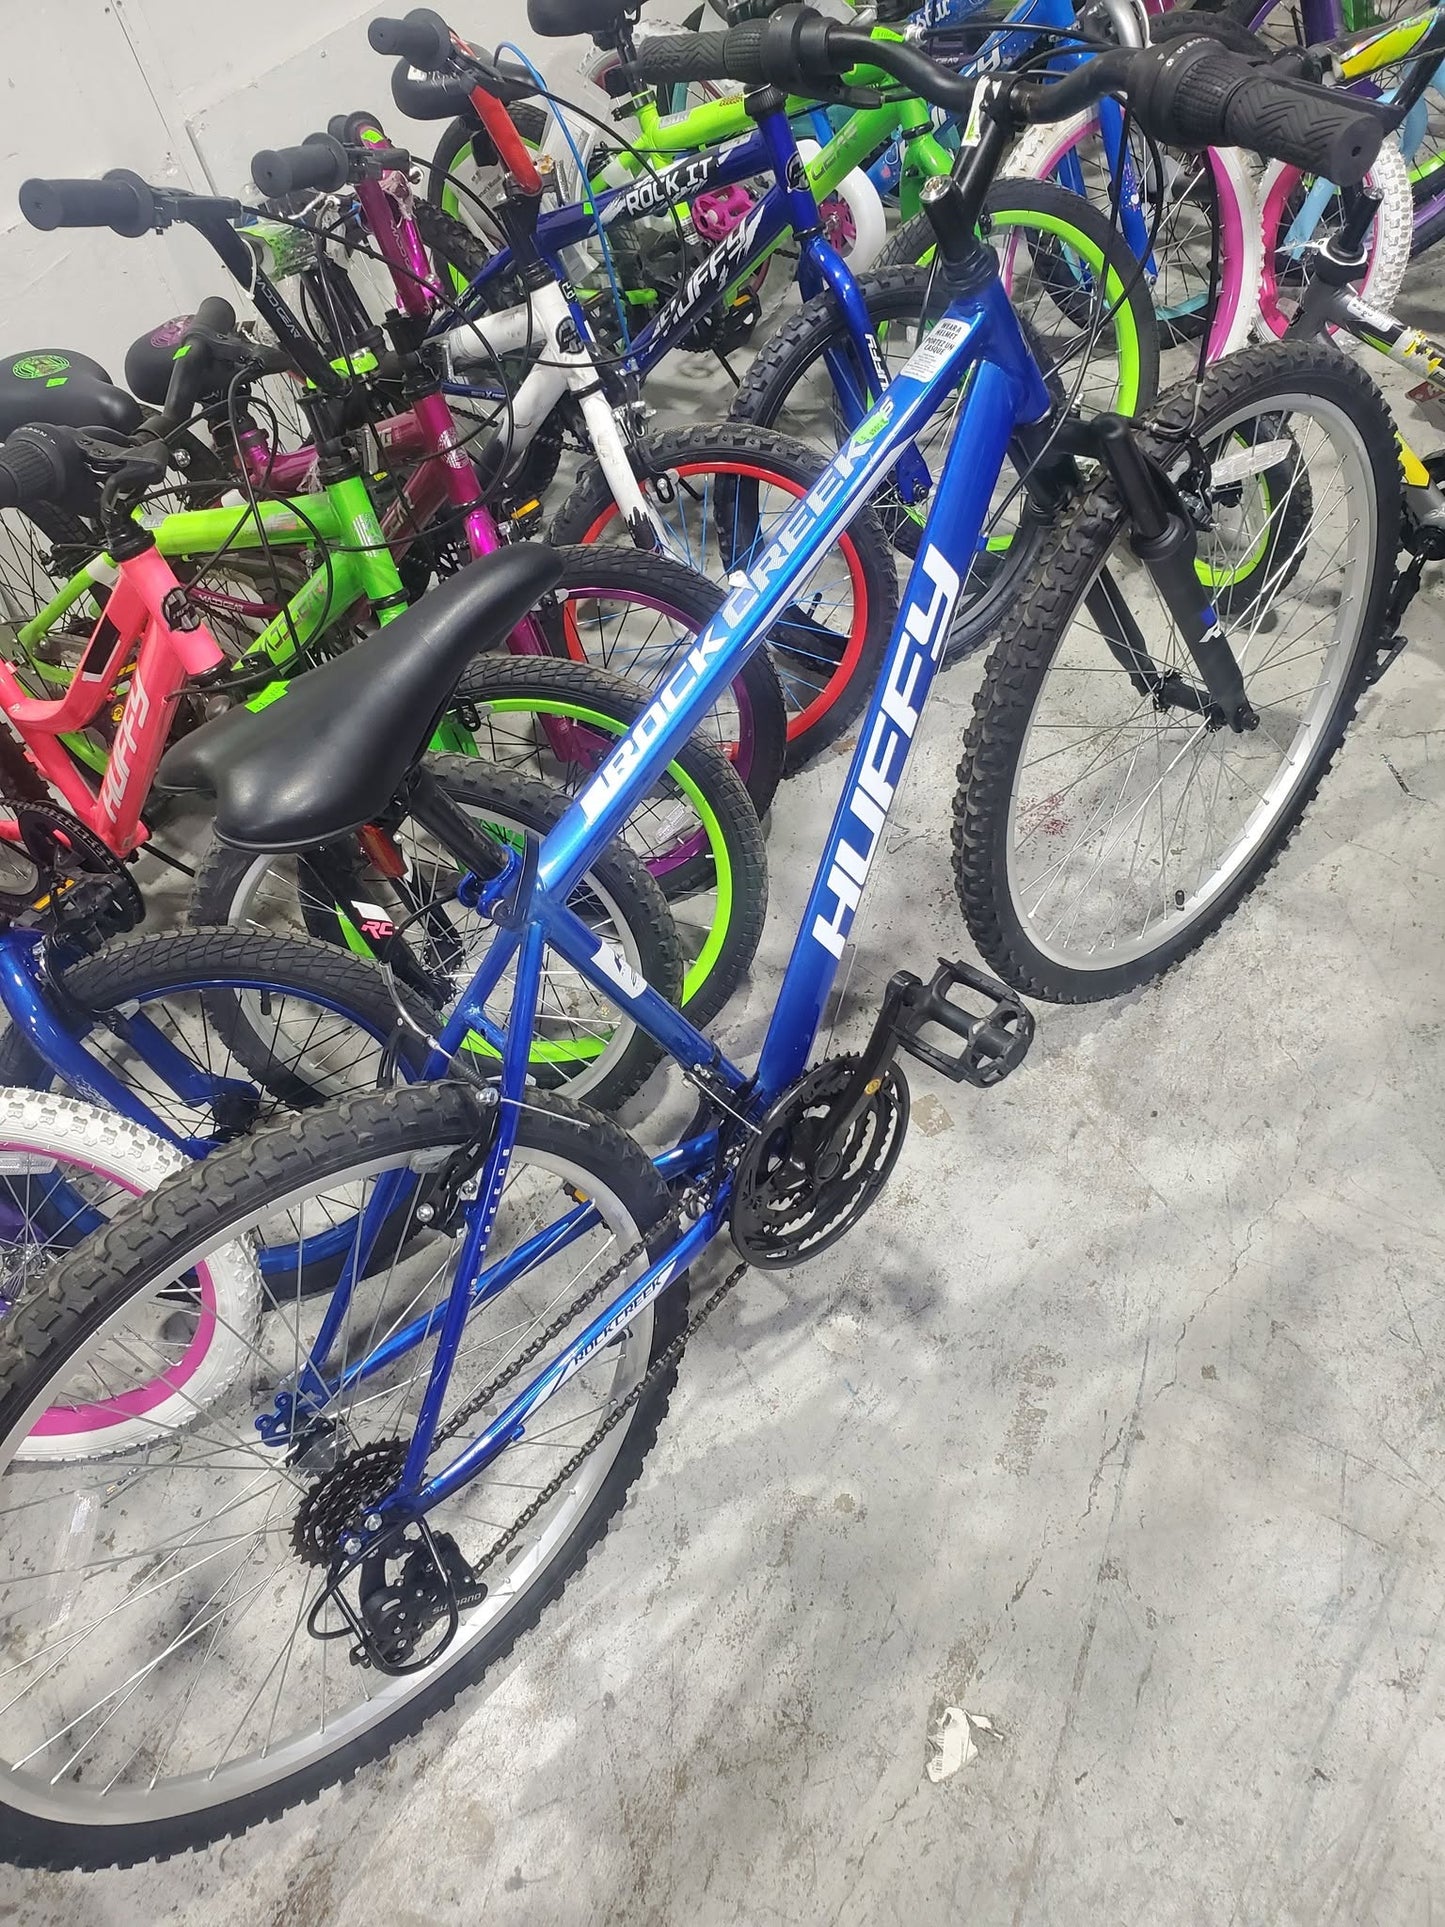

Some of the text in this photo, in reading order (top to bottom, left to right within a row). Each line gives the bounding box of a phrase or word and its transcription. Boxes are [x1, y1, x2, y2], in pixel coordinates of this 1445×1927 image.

[626, 156, 713, 216] ROCK IT
[934, 329, 958, 341] HELMET
[941, 322, 958, 332] WEAR
[924, 343, 946, 356] CASQUE
[925, 336, 955, 351] PORTEZ UN
[605, 438, 877, 794] ROCK CREEK
[103, 667, 150, 824] HUFFY
[812, 542, 960, 961] HUFFY
[361, 920, 393, 939] RC
[432, 1592, 482, 1615] SHANO
